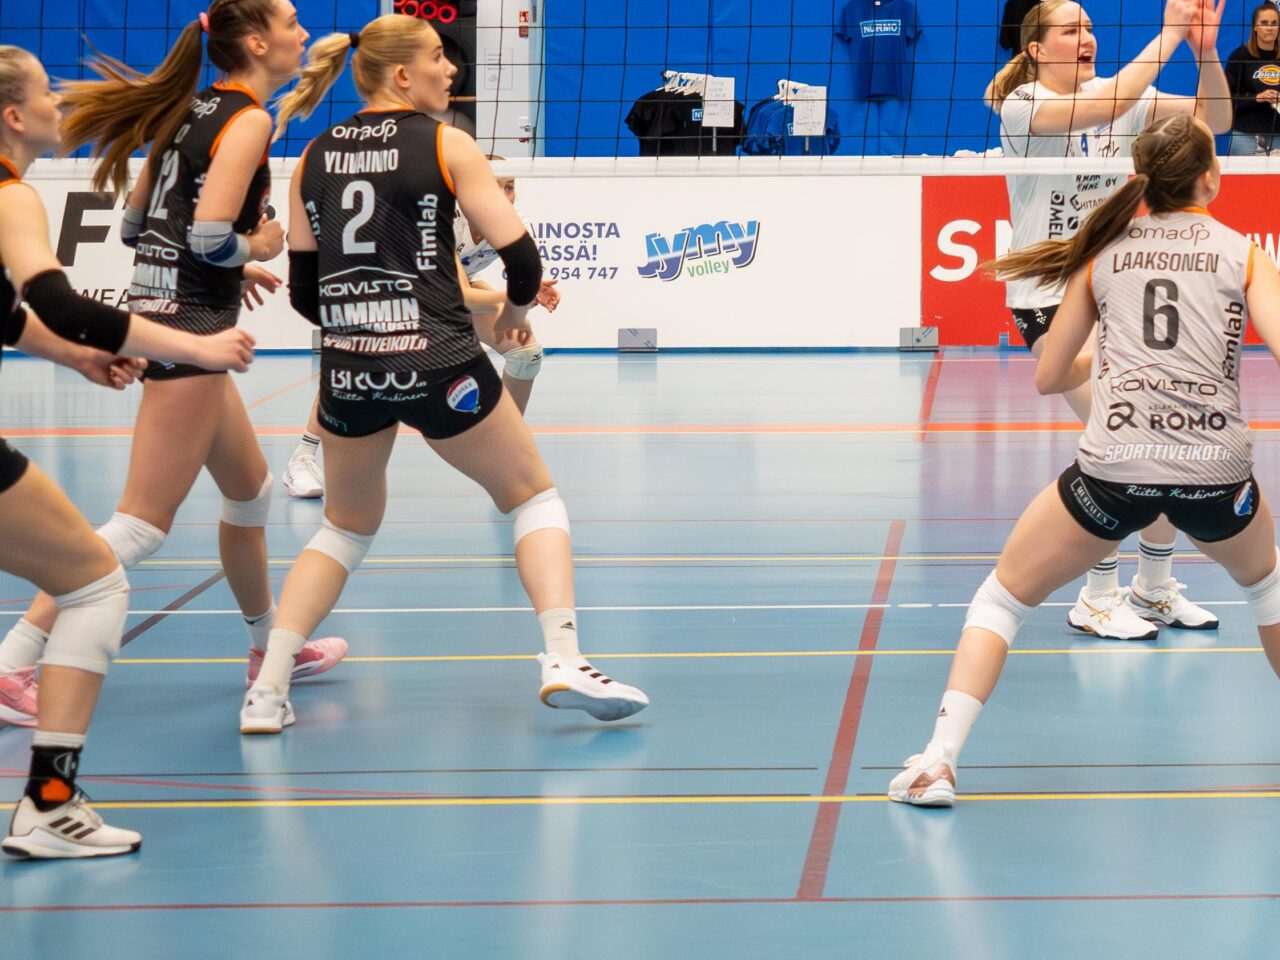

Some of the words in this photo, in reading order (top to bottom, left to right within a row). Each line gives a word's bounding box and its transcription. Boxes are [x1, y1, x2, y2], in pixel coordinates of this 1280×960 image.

[341, 180, 376, 255] 2
[1048, 209, 1063, 240] MEL
[416, 193, 438, 271] Fimlab
[687, 260, 730, 277] volley
[1113, 251, 1219, 274] LAAKSONEN
[551, 267, 581, 280] 954
[588, 267, 619, 280] 747
[319, 279, 413, 297] KOIVISTO
[320, 297, 420, 328] LAMMIN
[1143, 278, 1179, 350] 6
[1110, 378, 1217, 396] KOIVISTO
[1150, 411, 1227, 431] ROMO
[1104, 443, 1231, 461] SPORTTIVEIKOT.fi
